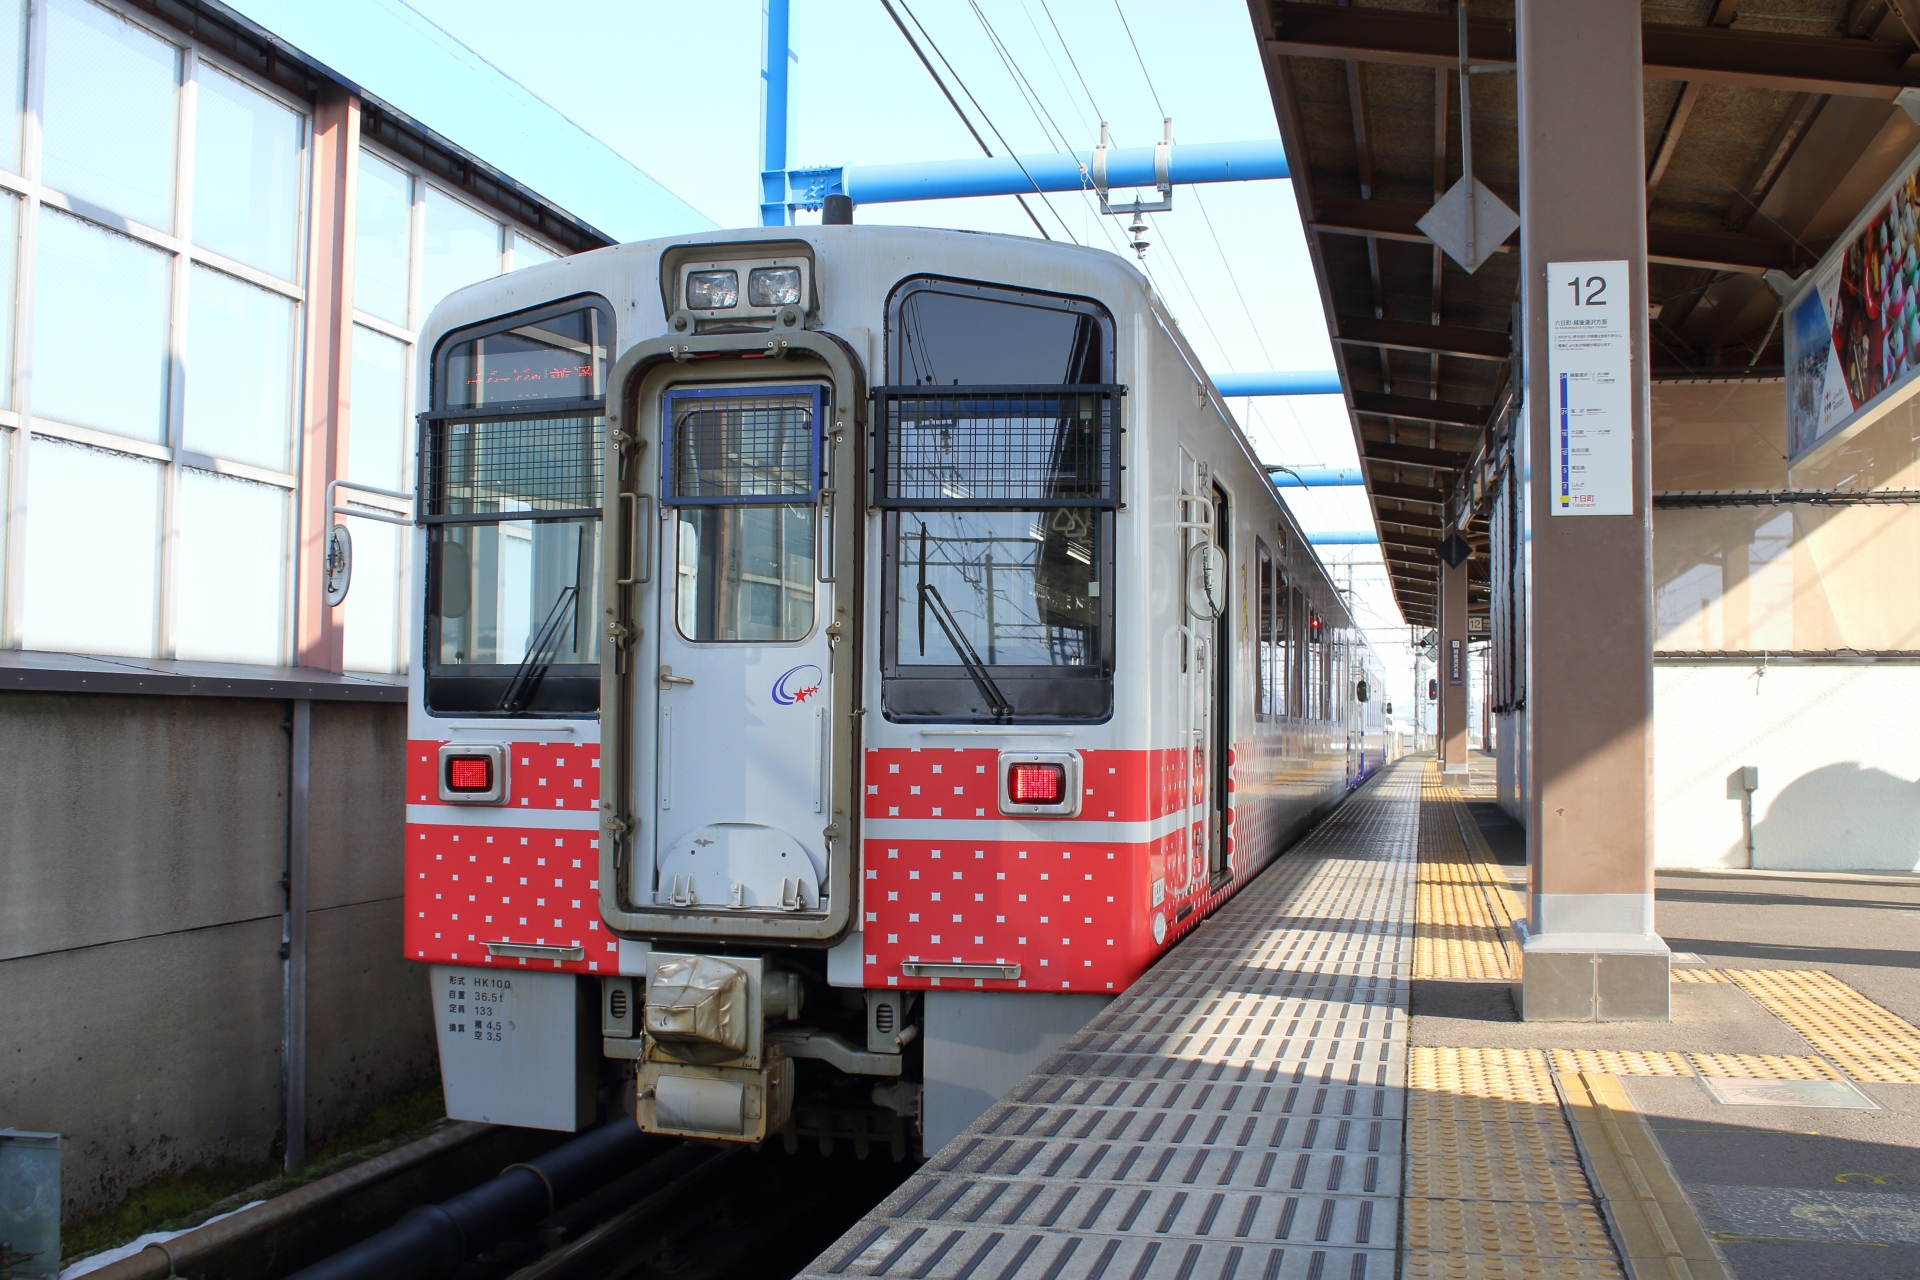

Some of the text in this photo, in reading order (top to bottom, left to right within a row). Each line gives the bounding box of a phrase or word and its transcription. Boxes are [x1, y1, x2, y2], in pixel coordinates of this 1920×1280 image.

[1567, 276, 1607, 306] 12
[1470, 620, 1480, 629] 12
[1430, 650, 1436, 659] 3
[449, 975, 511, 989] 形式 HK100
[449, 990, 466, 999] 自重
[449, 1004, 493, 1016] 定員 133
[449, 1023, 466, 1033] 換算
[486, 1021, 502, 1031] 4.5
[474, 1031, 502, 1042] 空 3.5
